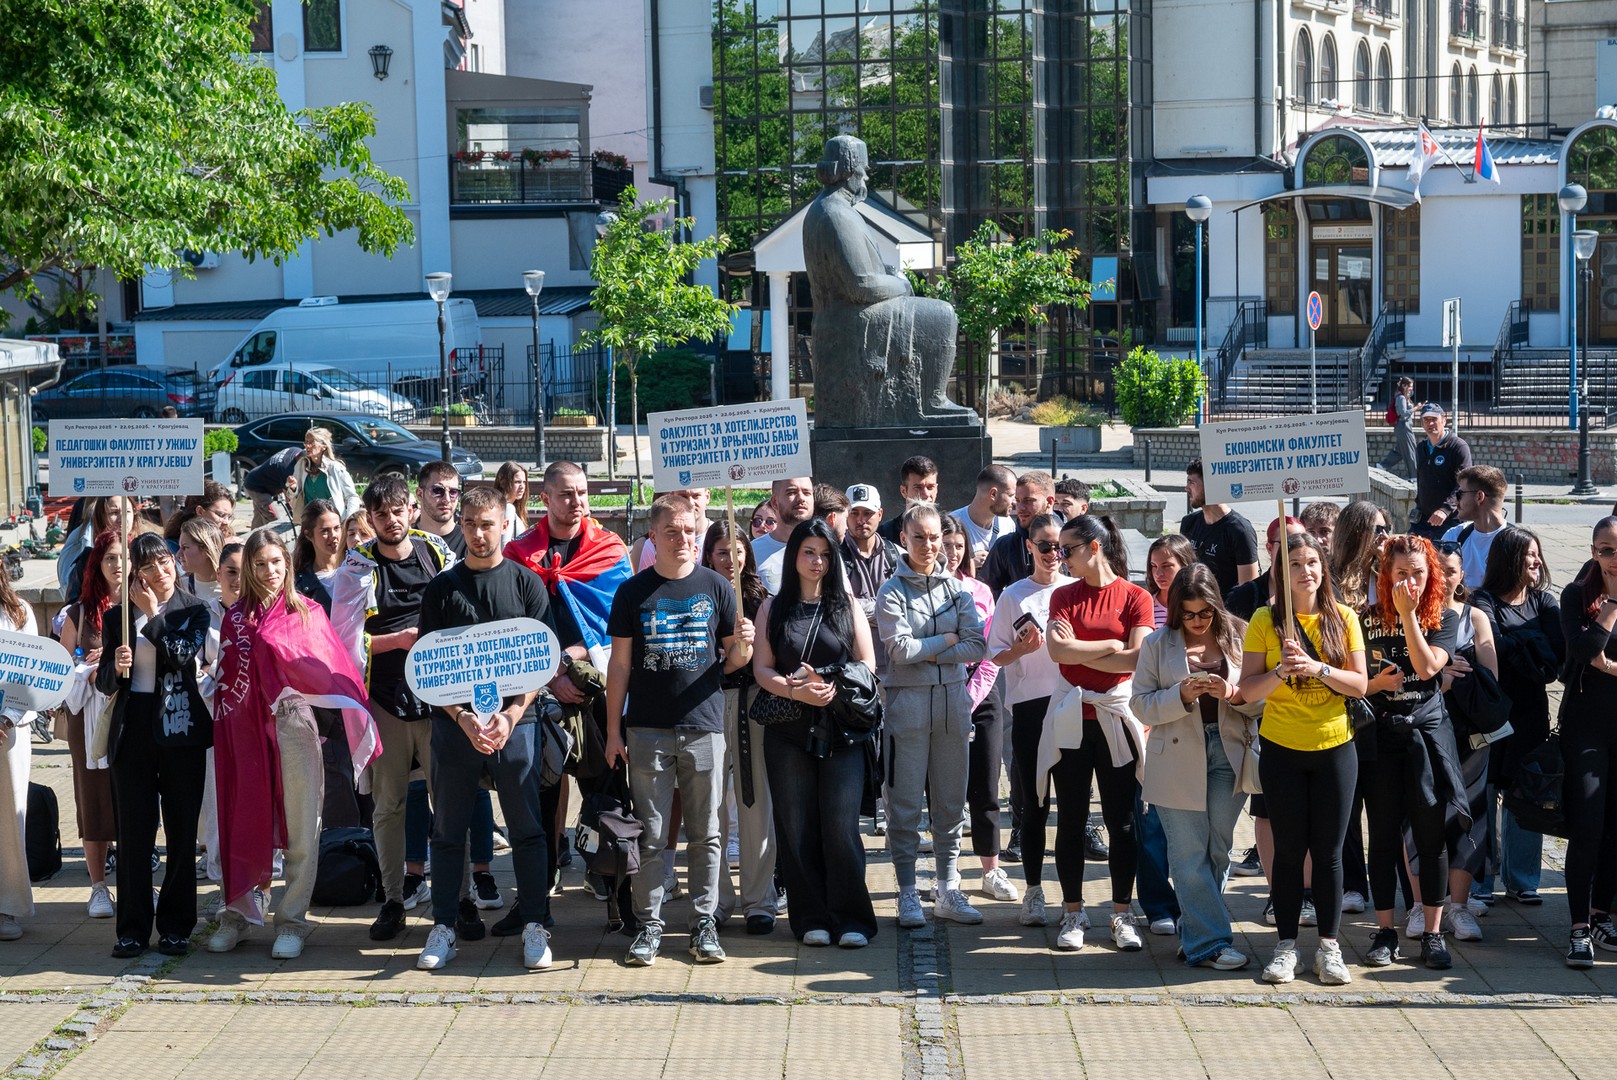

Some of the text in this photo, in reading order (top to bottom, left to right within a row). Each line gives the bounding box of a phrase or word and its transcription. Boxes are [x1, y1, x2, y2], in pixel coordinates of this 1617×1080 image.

[660, 415, 797, 440] ФАКУЛТЕТ ЗА ХОТЕЛИЈЕРСТВО
[56, 438, 197, 451] ПЕДАГОШКИ ФАКУЛТЕТ У УЖИЦУ
[661, 429, 799, 454] И ТУРИЗАМ У ВРЊАЧКОЈ БАЊИ
[1226, 434, 1342, 456] ЕКОНОМСКИ ФАКУЛТЕТ
[60, 456, 193, 468] УНИВЕРЗИТЕТА У КРАГУЈЕВЦУ
[663, 443, 799, 468] УНИВЕРЗИТЕТА У КРАГУЈЕВЦУ
[748, 463, 786, 471] УНИВЕРЗИТЕТ
[1211, 451, 1360, 475] УНИВЕРЗИТЕТА У КРАГУЈЕВЦУ
[753, 468, 787, 476] КРАГУЈЕВЦУ
[414, 631, 548, 662] ФАКУЛТЕТ ЗА ХОТЕЛИЈЕРСТВО
[30, 658, 38, 669] У
[38, 660, 71, 676] УЖИЦУ
[415, 645, 550, 677] И ТУРИЗАМ У ВРЊАЧКОЈ БАЊИ
[7, 672, 63, 691] КРАГУЈЕВЦУ
[416, 658, 551, 690] УНИВЕРЗИТЕТА У КРАГУЈЕВЦУ
